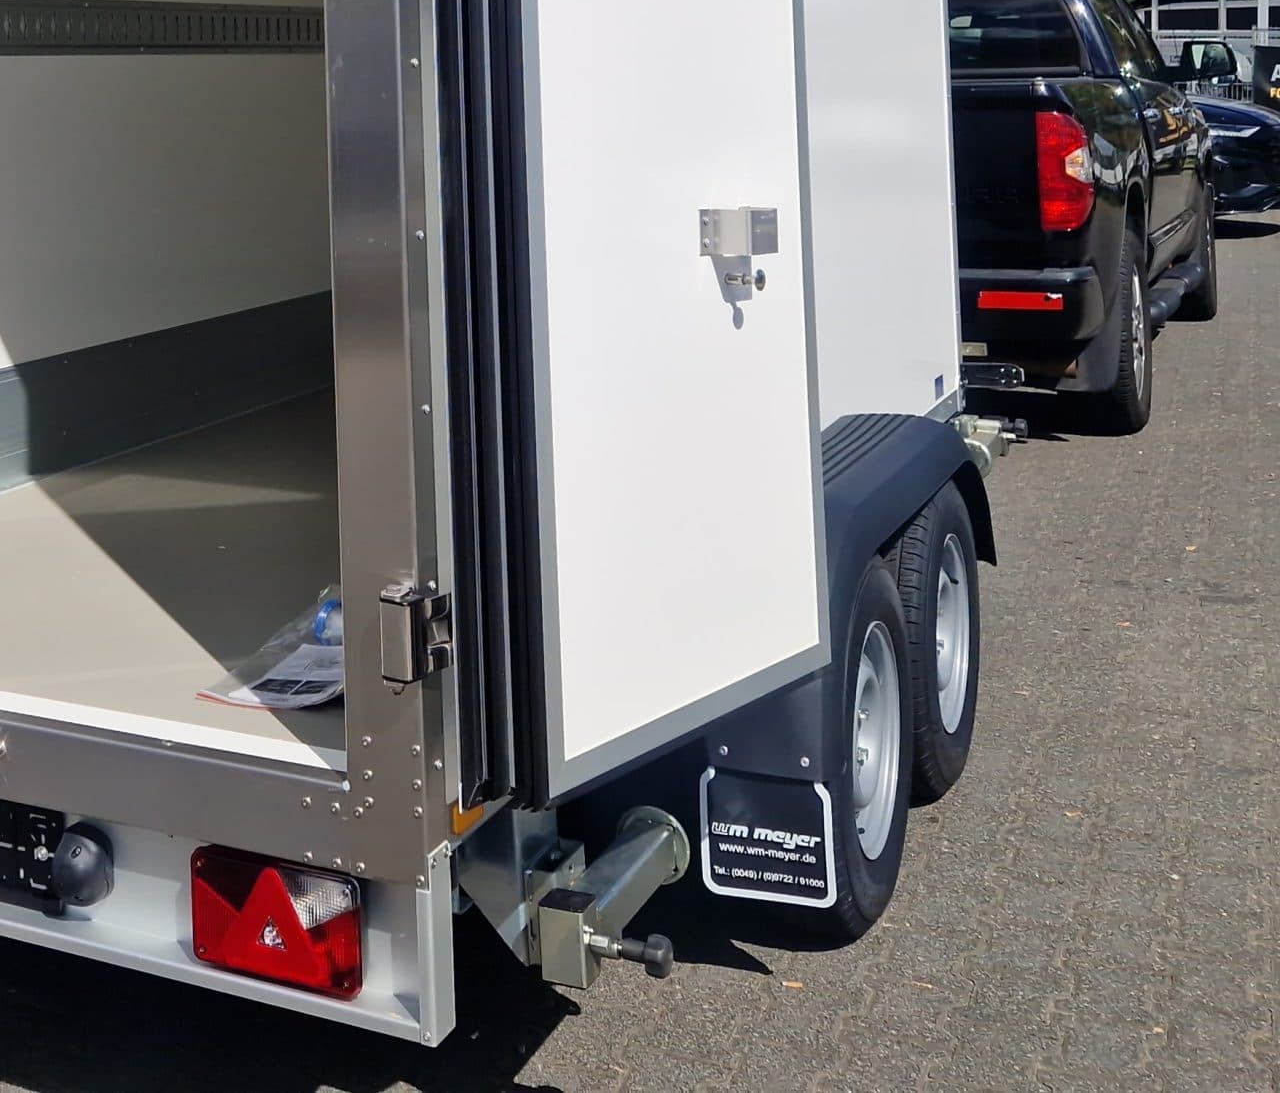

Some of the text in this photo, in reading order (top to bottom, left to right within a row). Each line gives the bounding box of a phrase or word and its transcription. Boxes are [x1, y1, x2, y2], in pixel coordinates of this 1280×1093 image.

[753, 827, 821, 849] meyer
[718, 842, 817, 864] www.wm-meyer.de
[731, 868, 757, 880] (0049)
